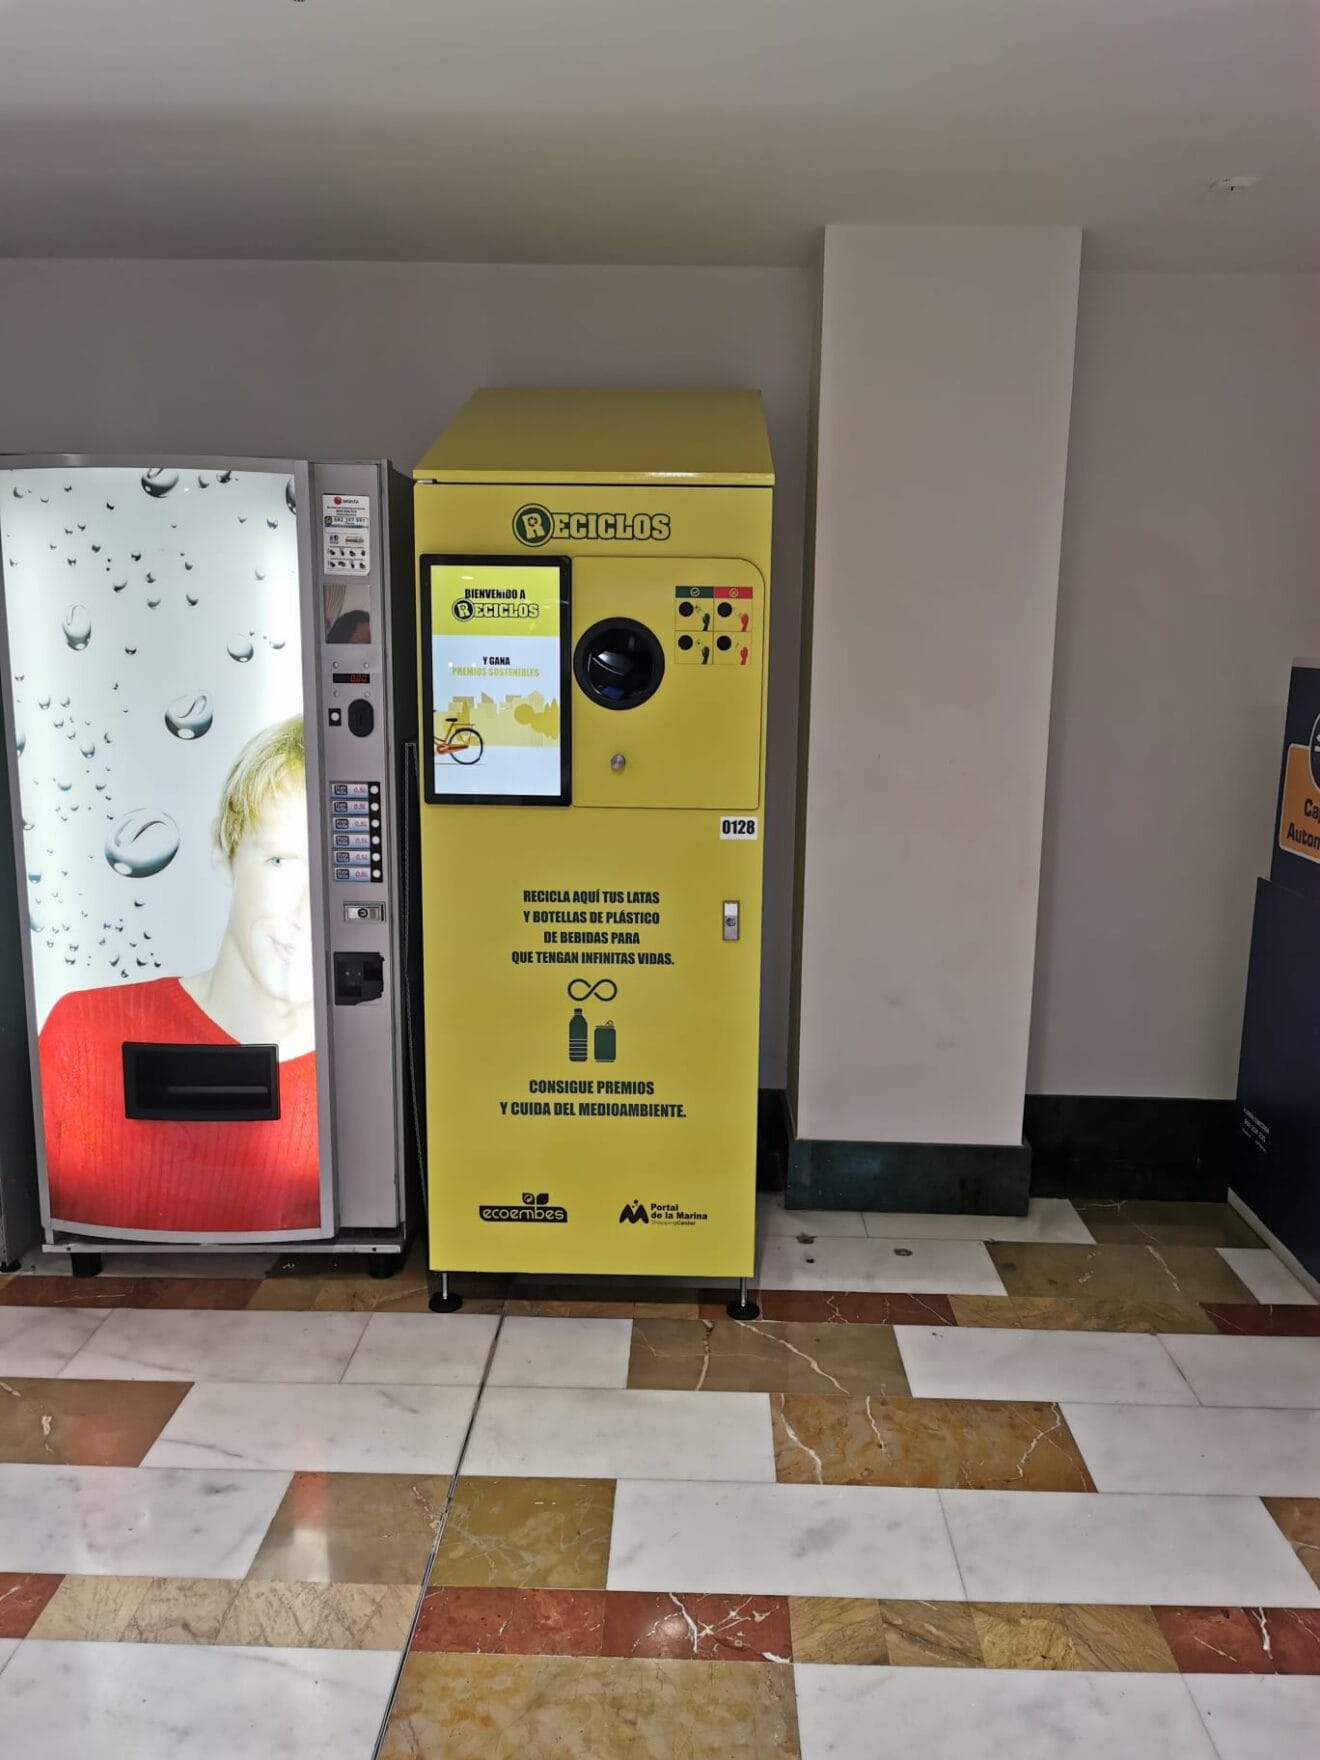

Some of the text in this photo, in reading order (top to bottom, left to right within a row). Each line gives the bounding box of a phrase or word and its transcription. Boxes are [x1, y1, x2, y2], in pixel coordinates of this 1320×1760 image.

[512, 503, 671, 547] RECICLOS
[465, 589, 526, 599] BIENVENIDO A
[452, 598, 539, 622] RECICLOS
[483, 656, 510, 665] Y GANA
[452, 667, 540, 678] PREMIOS SOSTENIBLES
[1304, 798, 1320, 824] Ca
[722, 819, 755, 834] 0128
[523, 889, 660, 904] RECICLA AQUÍ TUS LATAS
[523, 909, 660, 924] Y BOTELLAS DE PLÁSTICO
[544, 931, 640, 944] DE BEBIDAS PARA
[512, 951, 675, 965] QUE TENGAN INFINITAS VIDAS.
[529, 1080, 654, 1095] CONSIGUE PREMIOS
[500, 1102, 687, 1118] Y CUIDA DEL MEDIOAMBIENTE.
[481, 1207, 565, 1220] ecoembes
[650, 1203, 678, 1211] Portal
[650, 1211, 662, 1219] de
[676, 1212, 708, 1220] Marina
